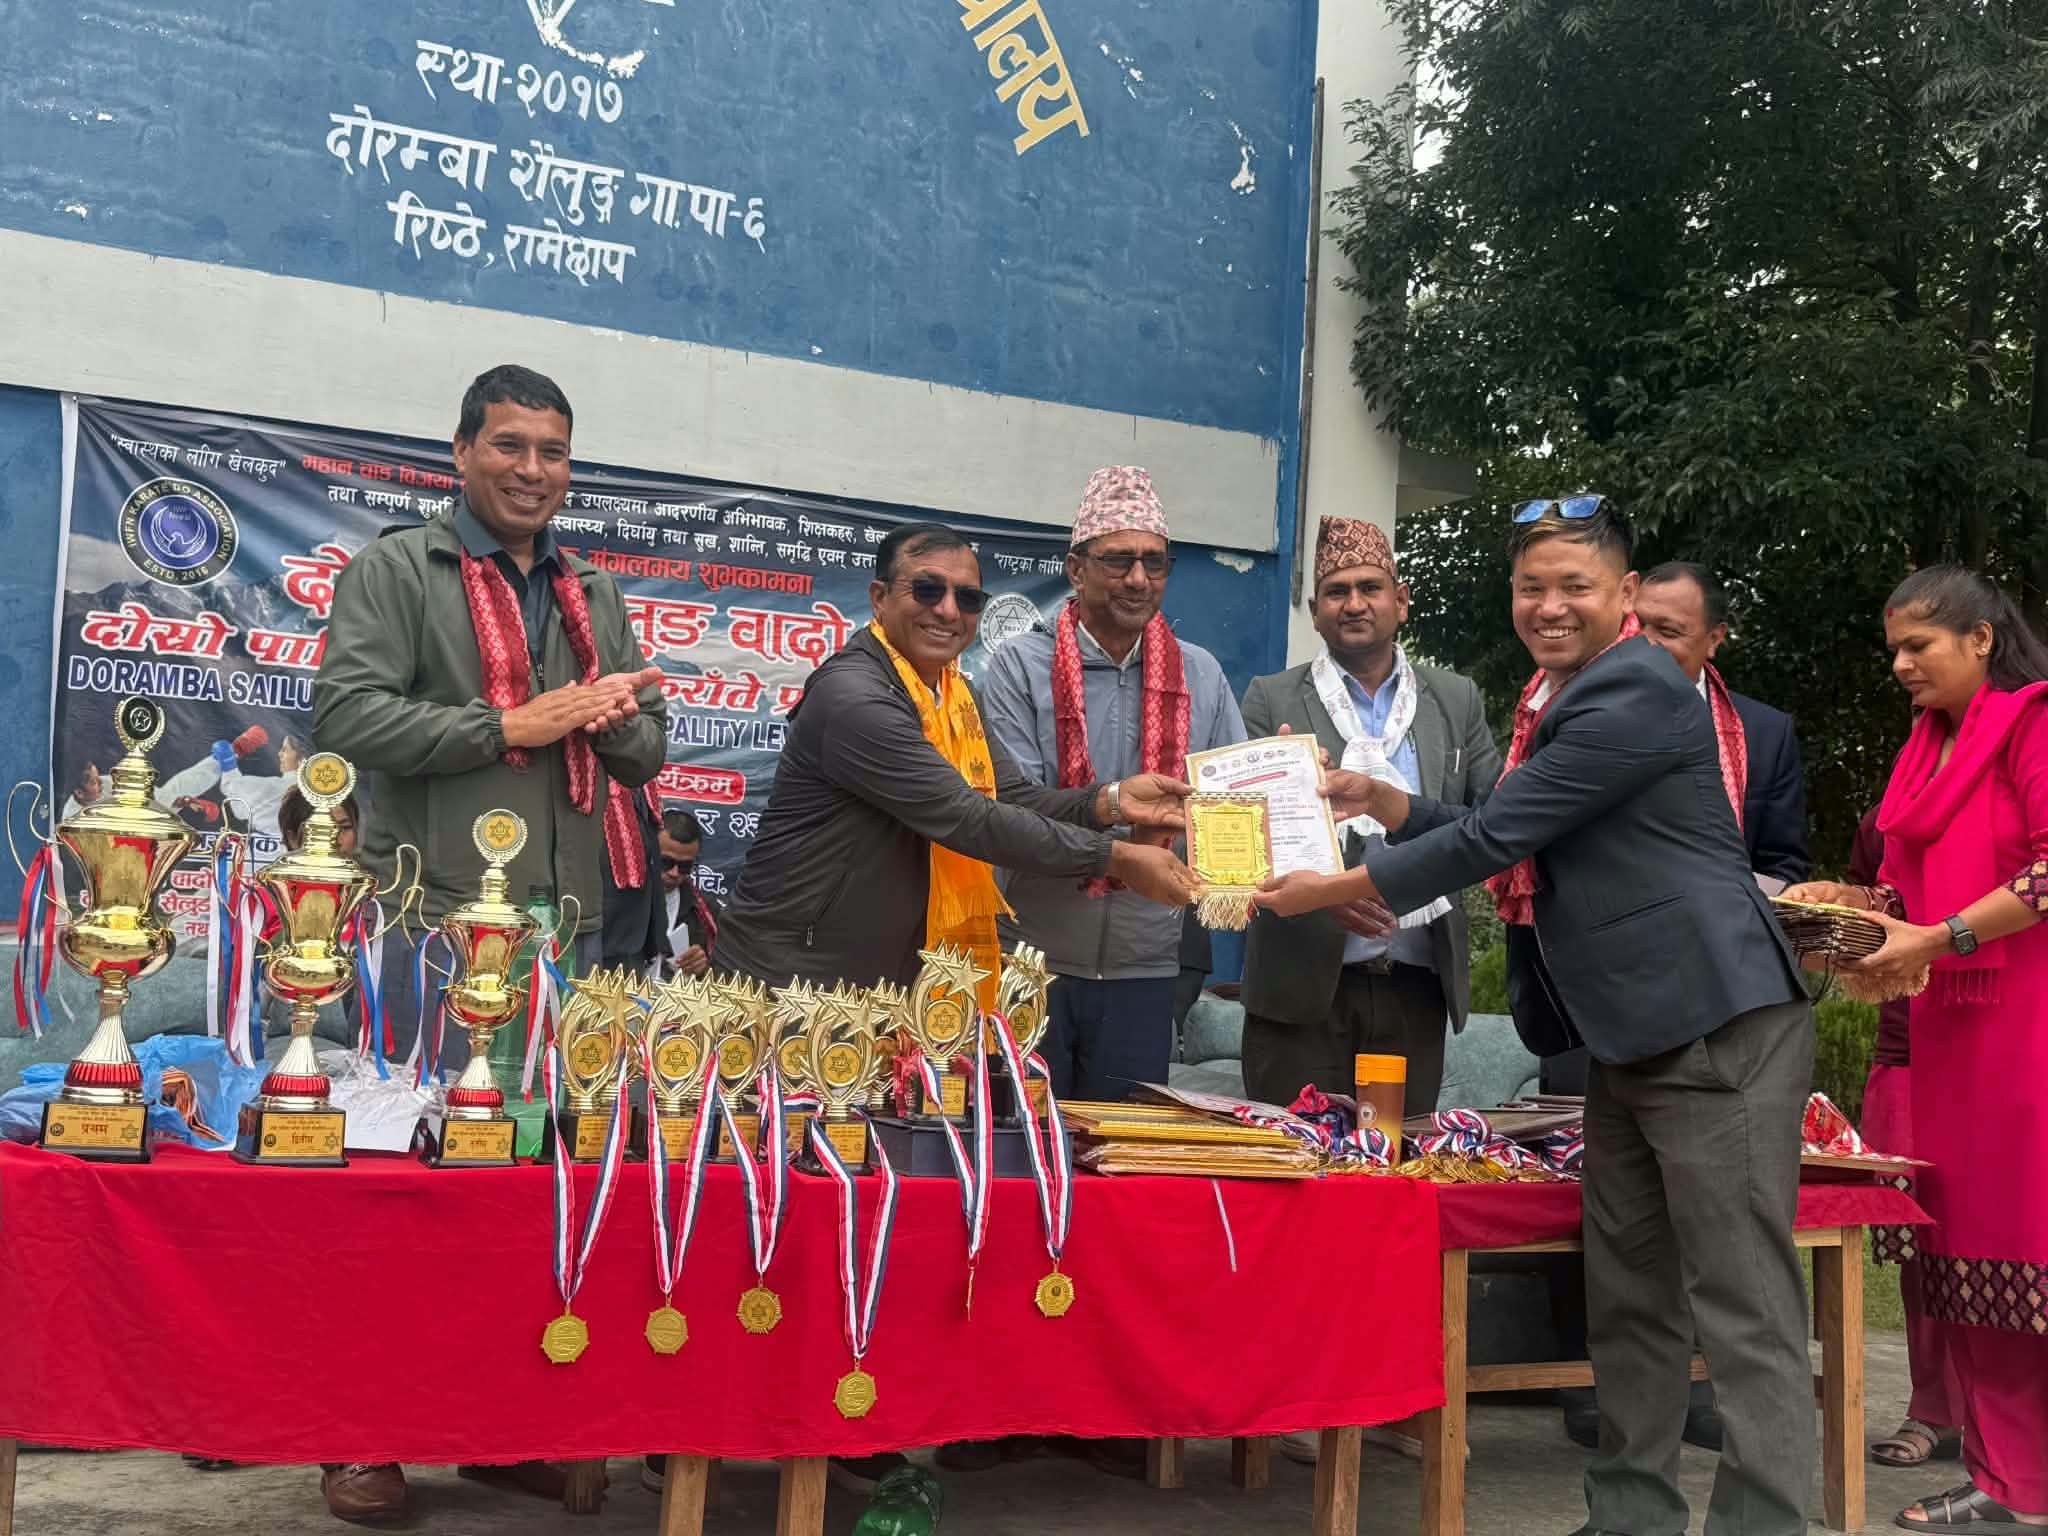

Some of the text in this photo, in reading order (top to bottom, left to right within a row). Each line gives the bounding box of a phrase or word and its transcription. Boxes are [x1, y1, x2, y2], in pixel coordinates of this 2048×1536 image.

[326, 103, 497, 193] दोरम्बा
[503, 218, 637, 288] रामेछाप
[303, 454, 353, 476] महान
[359, 463, 393, 481] चाड
[399, 463, 455, 489] विजया
[654, 502, 719, 522] आदरणीय
[722, 506, 791, 536] अभिभावक,
[328, 485, 359, 503] तथा
[662, 528, 689, 545] तथा
[694, 532, 722, 553] सुख,
[728, 533, 769, 560] शान्ति,
[817, 547, 847, 568] एवम्
[587, 547, 815, 596] मंगलमय शुभकामना
[81, 602, 239, 658] दोस्रो
[727, 601, 855, 668] वादो
[68, 655, 224, 702] DORAMBA
[229, 671, 313, 711] SAILU
